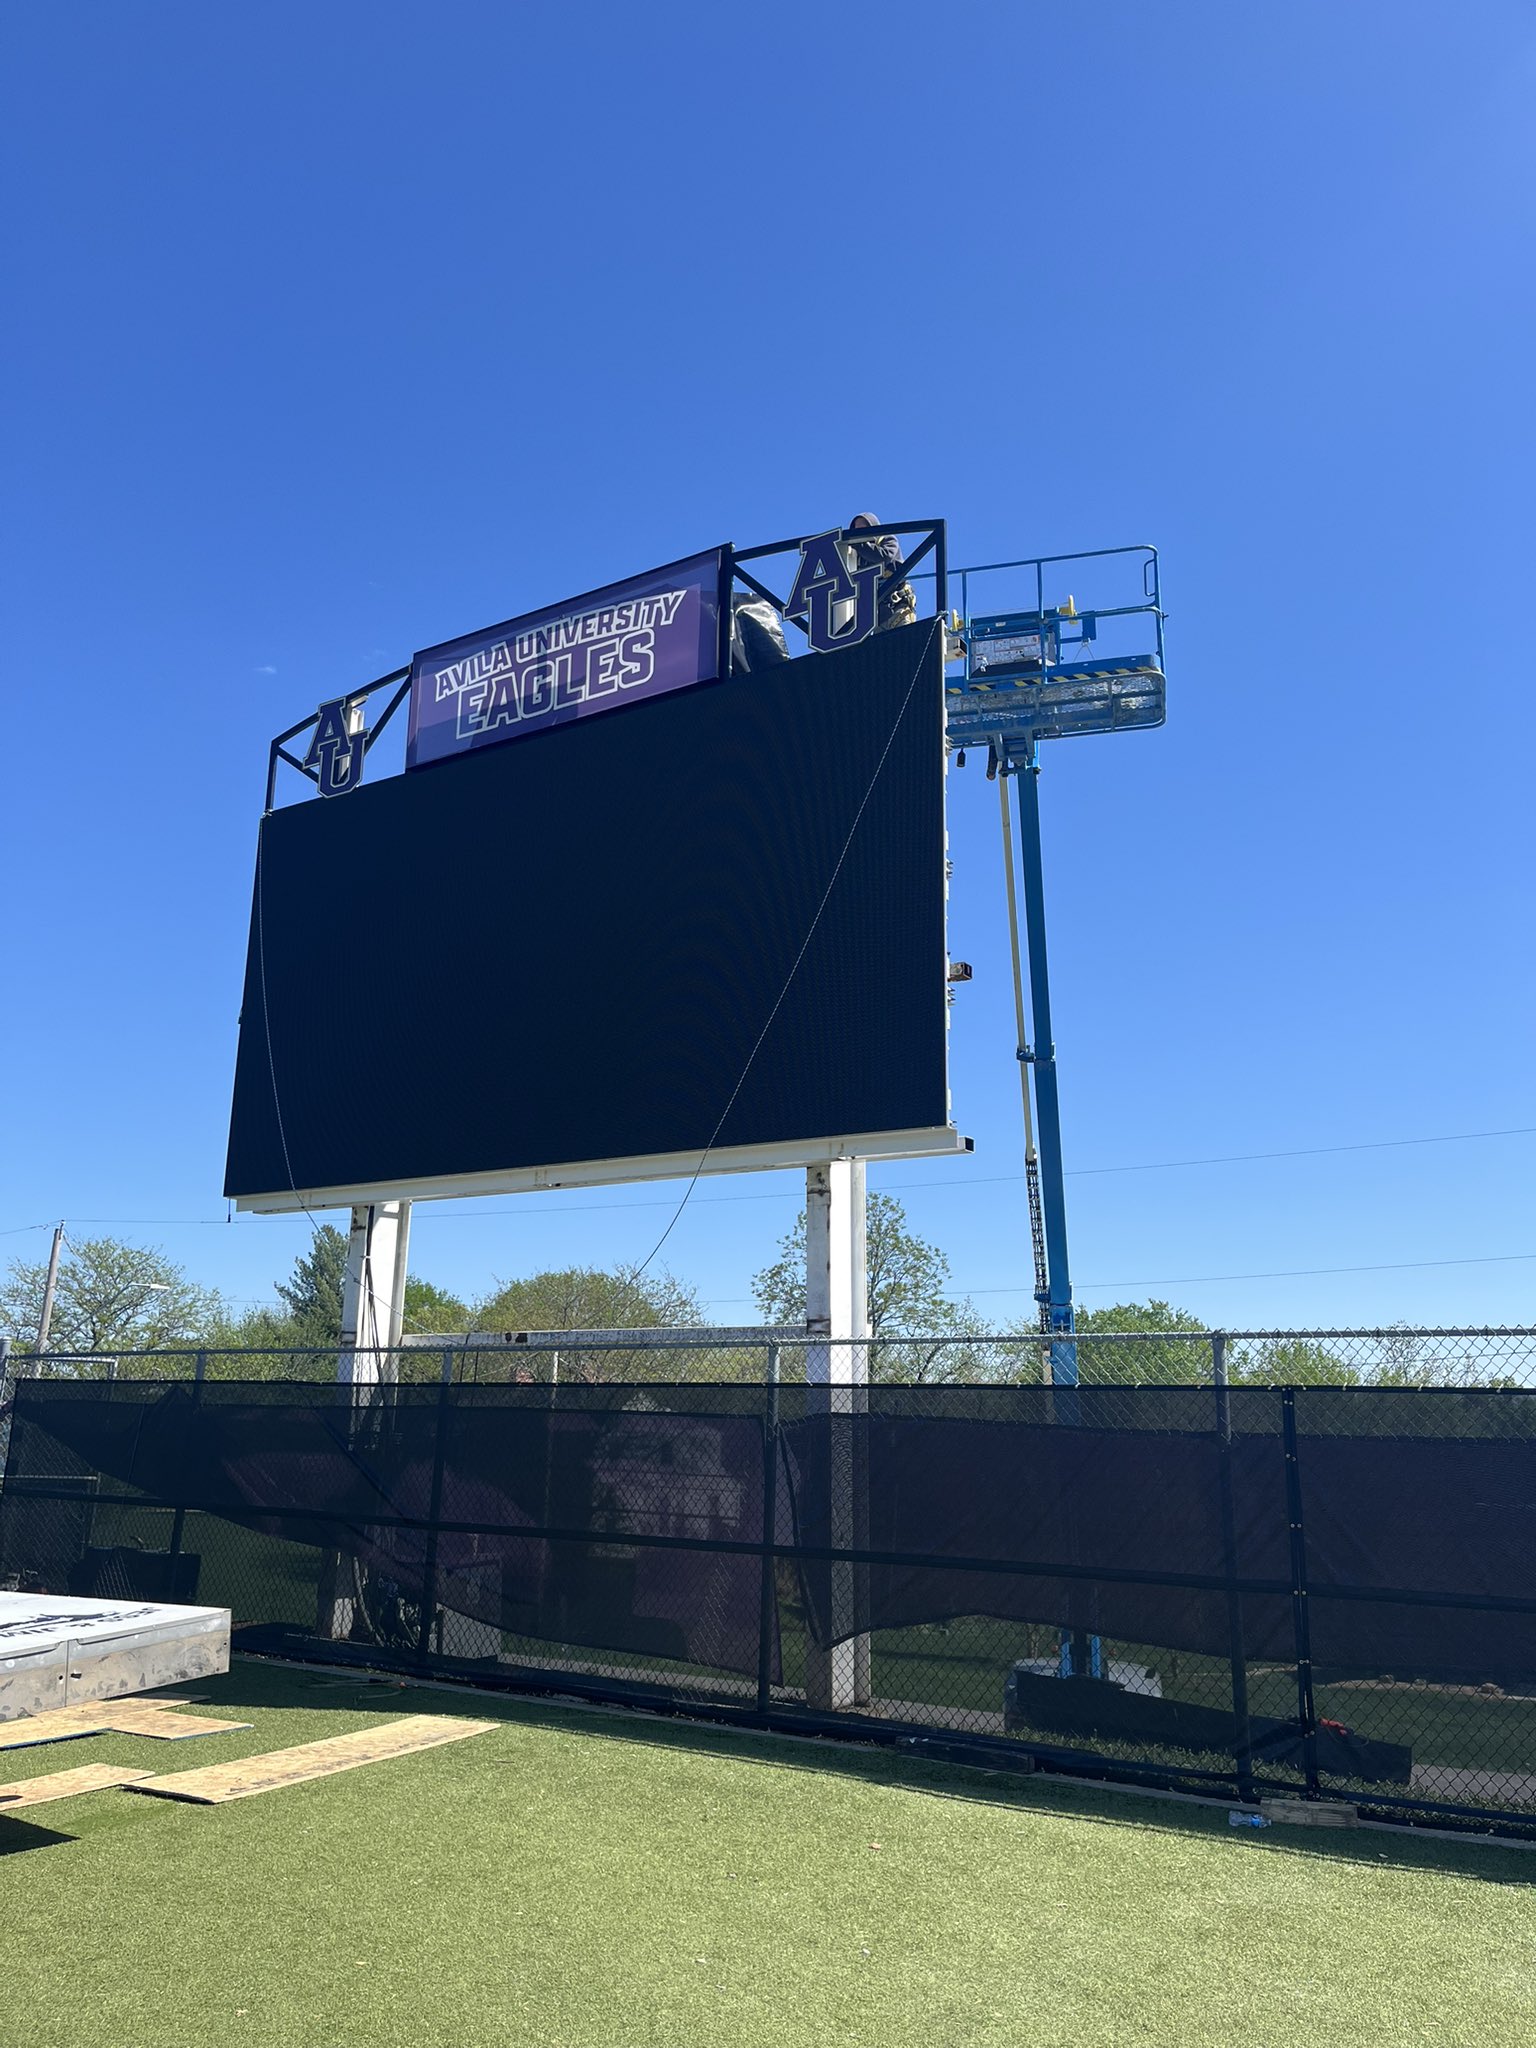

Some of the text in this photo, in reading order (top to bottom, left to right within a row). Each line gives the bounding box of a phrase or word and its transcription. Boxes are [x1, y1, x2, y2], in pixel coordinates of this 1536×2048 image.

[435, 590, 687, 702] AVILA UNIVERSITY
[456, 628, 655, 739] EAGLES
